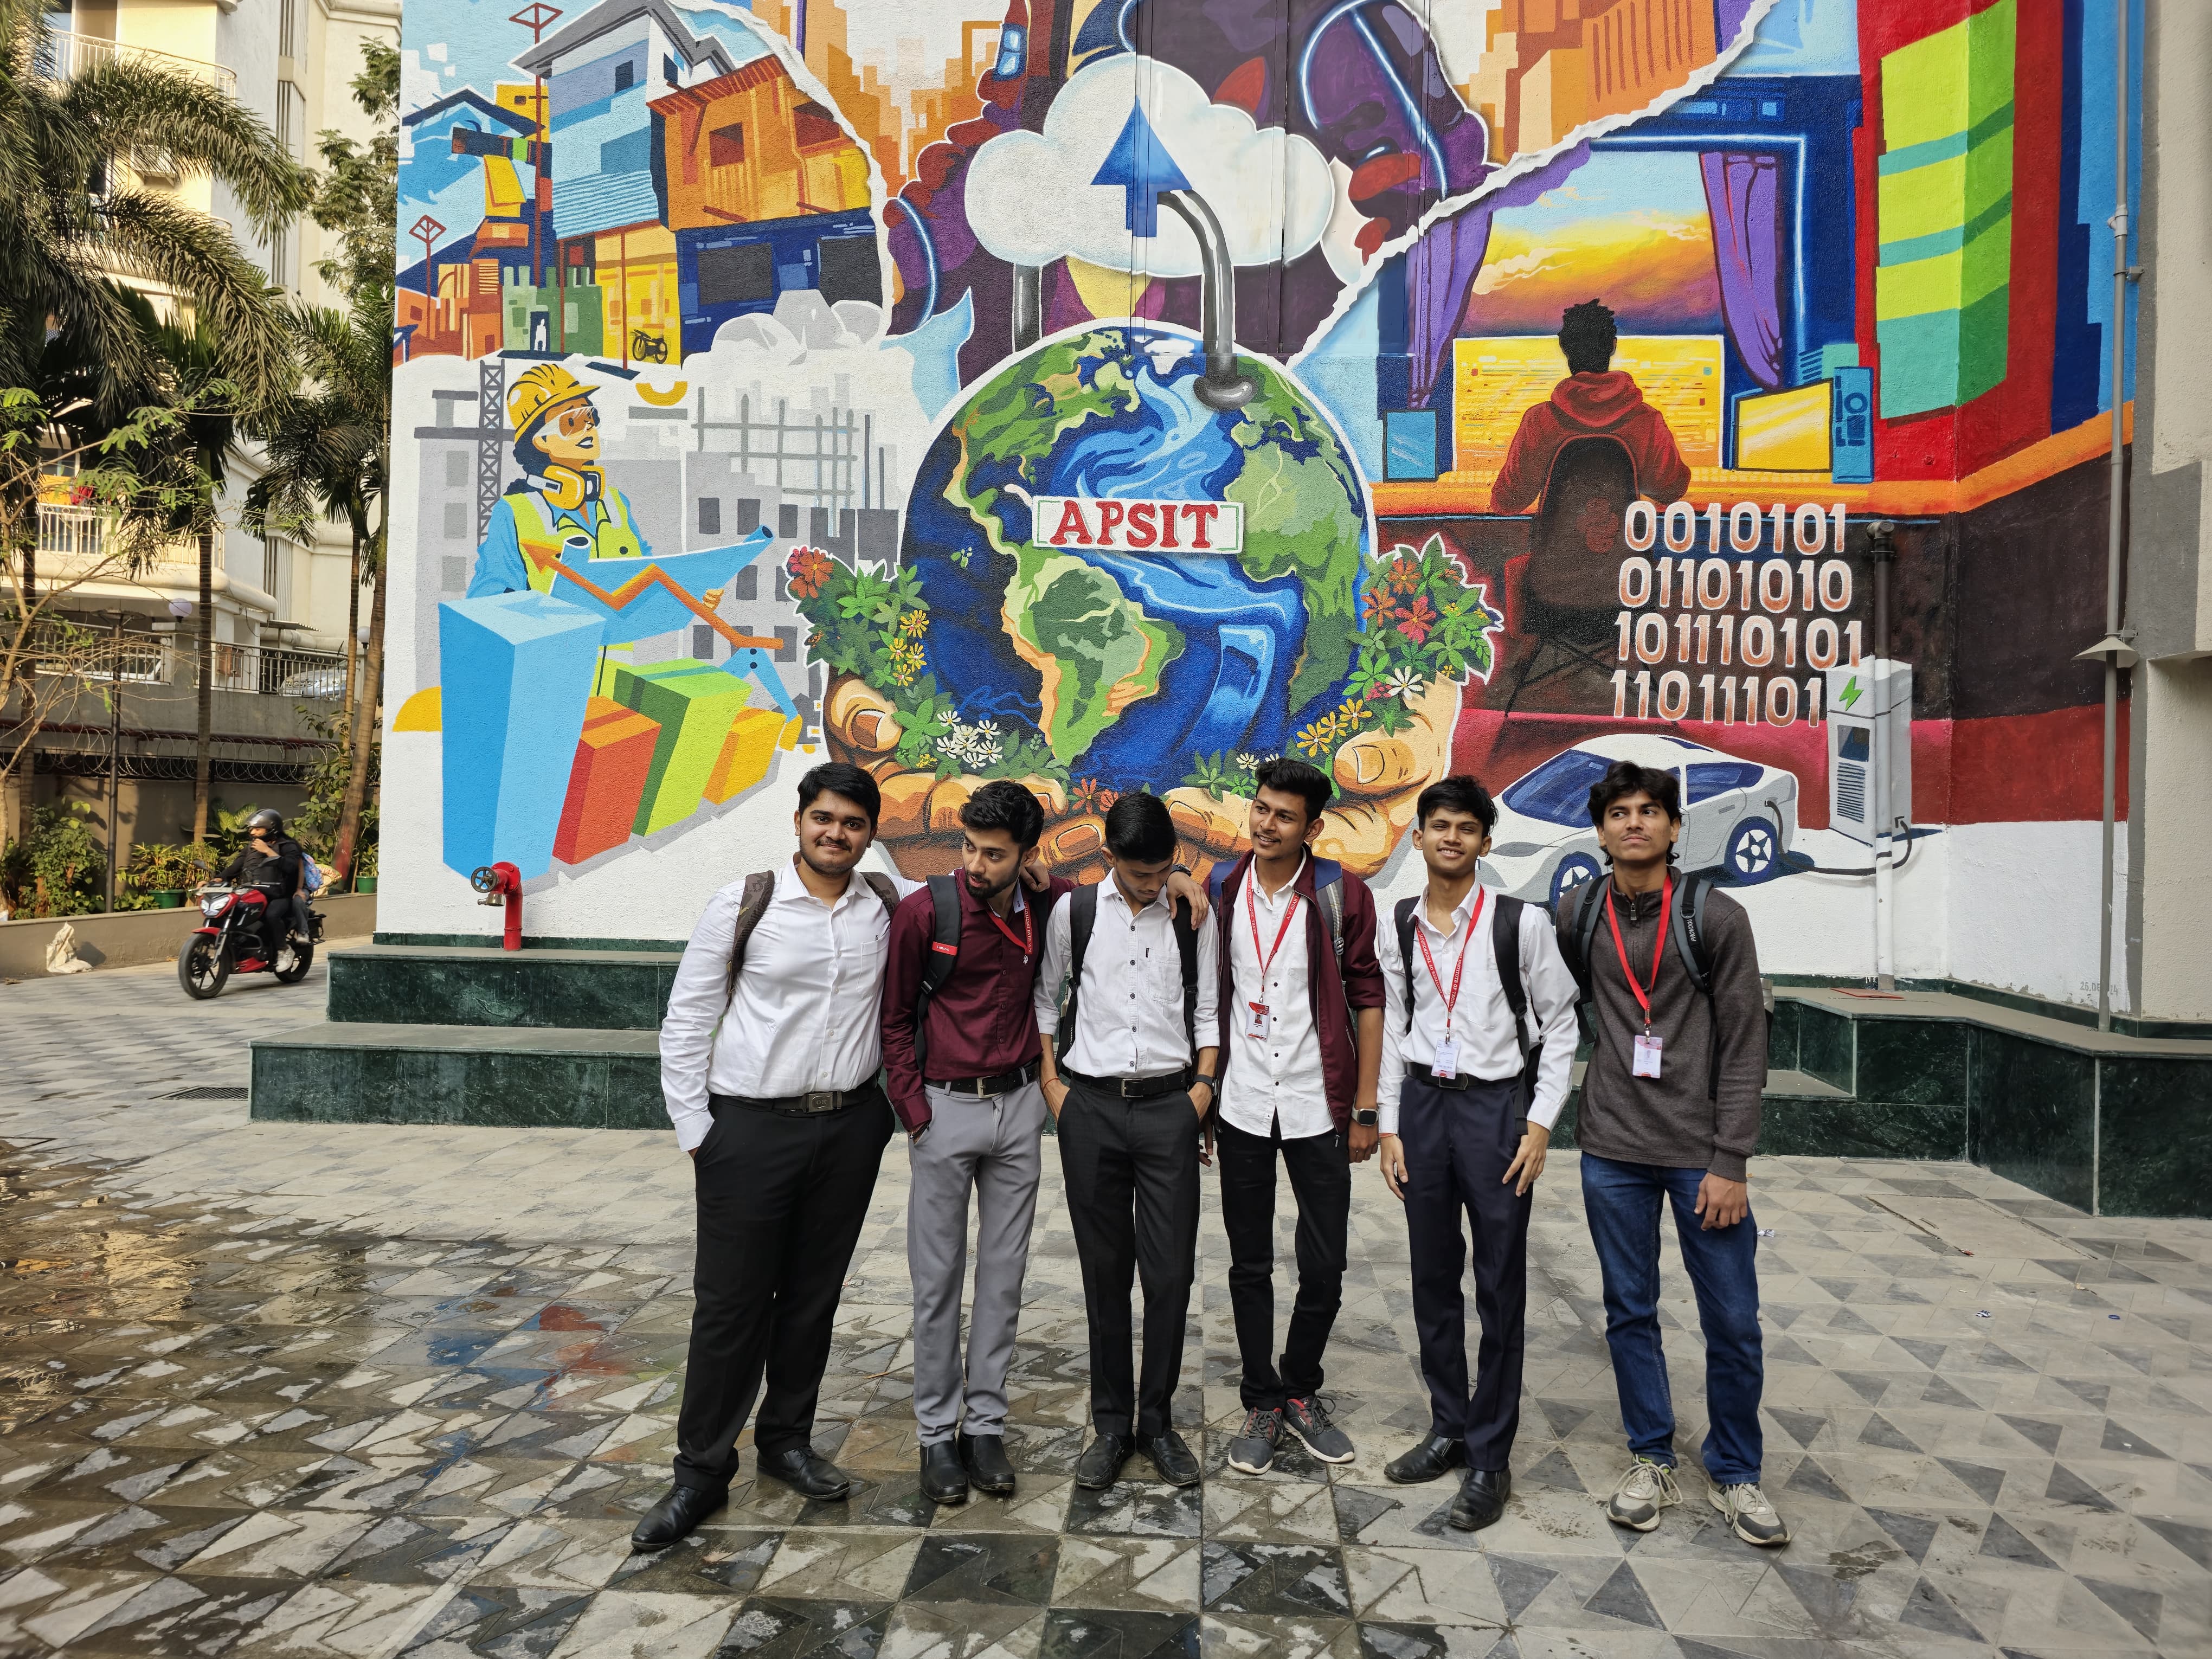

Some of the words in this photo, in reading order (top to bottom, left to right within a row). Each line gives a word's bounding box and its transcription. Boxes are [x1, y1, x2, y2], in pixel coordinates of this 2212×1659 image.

[1050, 500, 1219, 549] APSIT
[1625, 500, 1846, 555] 0010101
[1619, 556, 1852, 613] 01101010
[1615, 612, 1862, 671] 101110101
[1610, 670, 1822, 728] 11011101
[1687, 918, 1697, 941] PROVOGU
[1454, 959, 1462, 983] INSTITUTE
